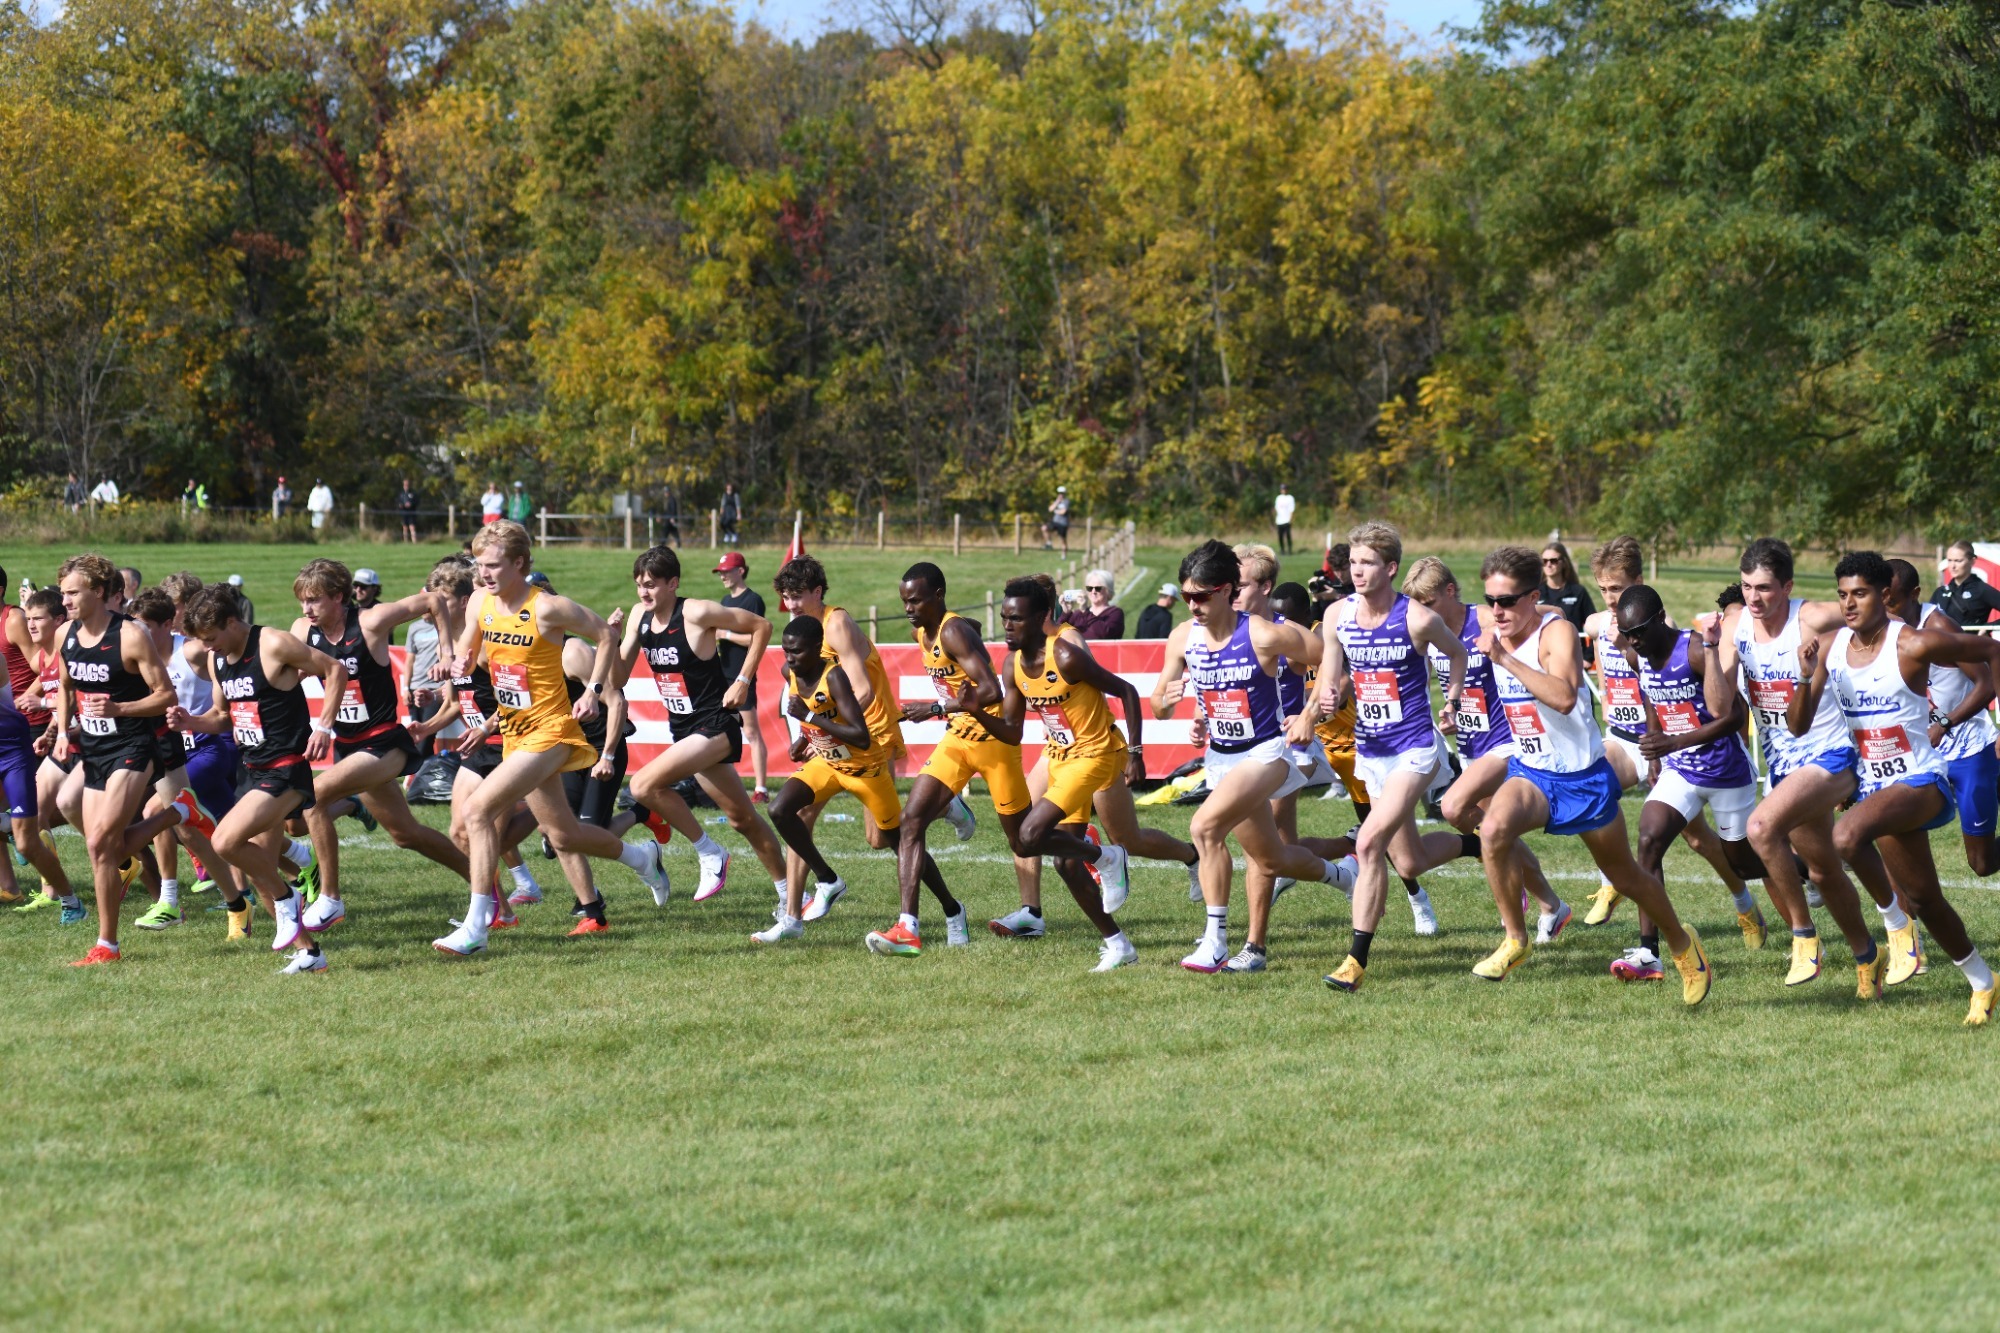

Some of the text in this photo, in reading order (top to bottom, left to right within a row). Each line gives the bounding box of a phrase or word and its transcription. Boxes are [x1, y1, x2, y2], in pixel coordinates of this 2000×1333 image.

[482, 630, 533, 647] MIZZOU
[643, 647, 679, 665] ZAGS
[1430, 654, 1483, 672] PORND
[67, 661, 110, 683] ZAGS
[1760, 664, 1797, 681] Force
[498, 690, 522, 706] 821
[664, 698, 686, 711] 715
[1855, 690, 1893, 708] Force
[1363, 703, 1391, 719] 891
[1614, 706, 1640, 722] 898
[85, 718, 109, 733] 718
[1216, 720, 1245, 737] 899
[1458, 712, 1482, 729] 894
[238, 729, 260, 744] 713
[1519, 736, 1543, 754] 567
[1870, 757, 1908, 778] 583
